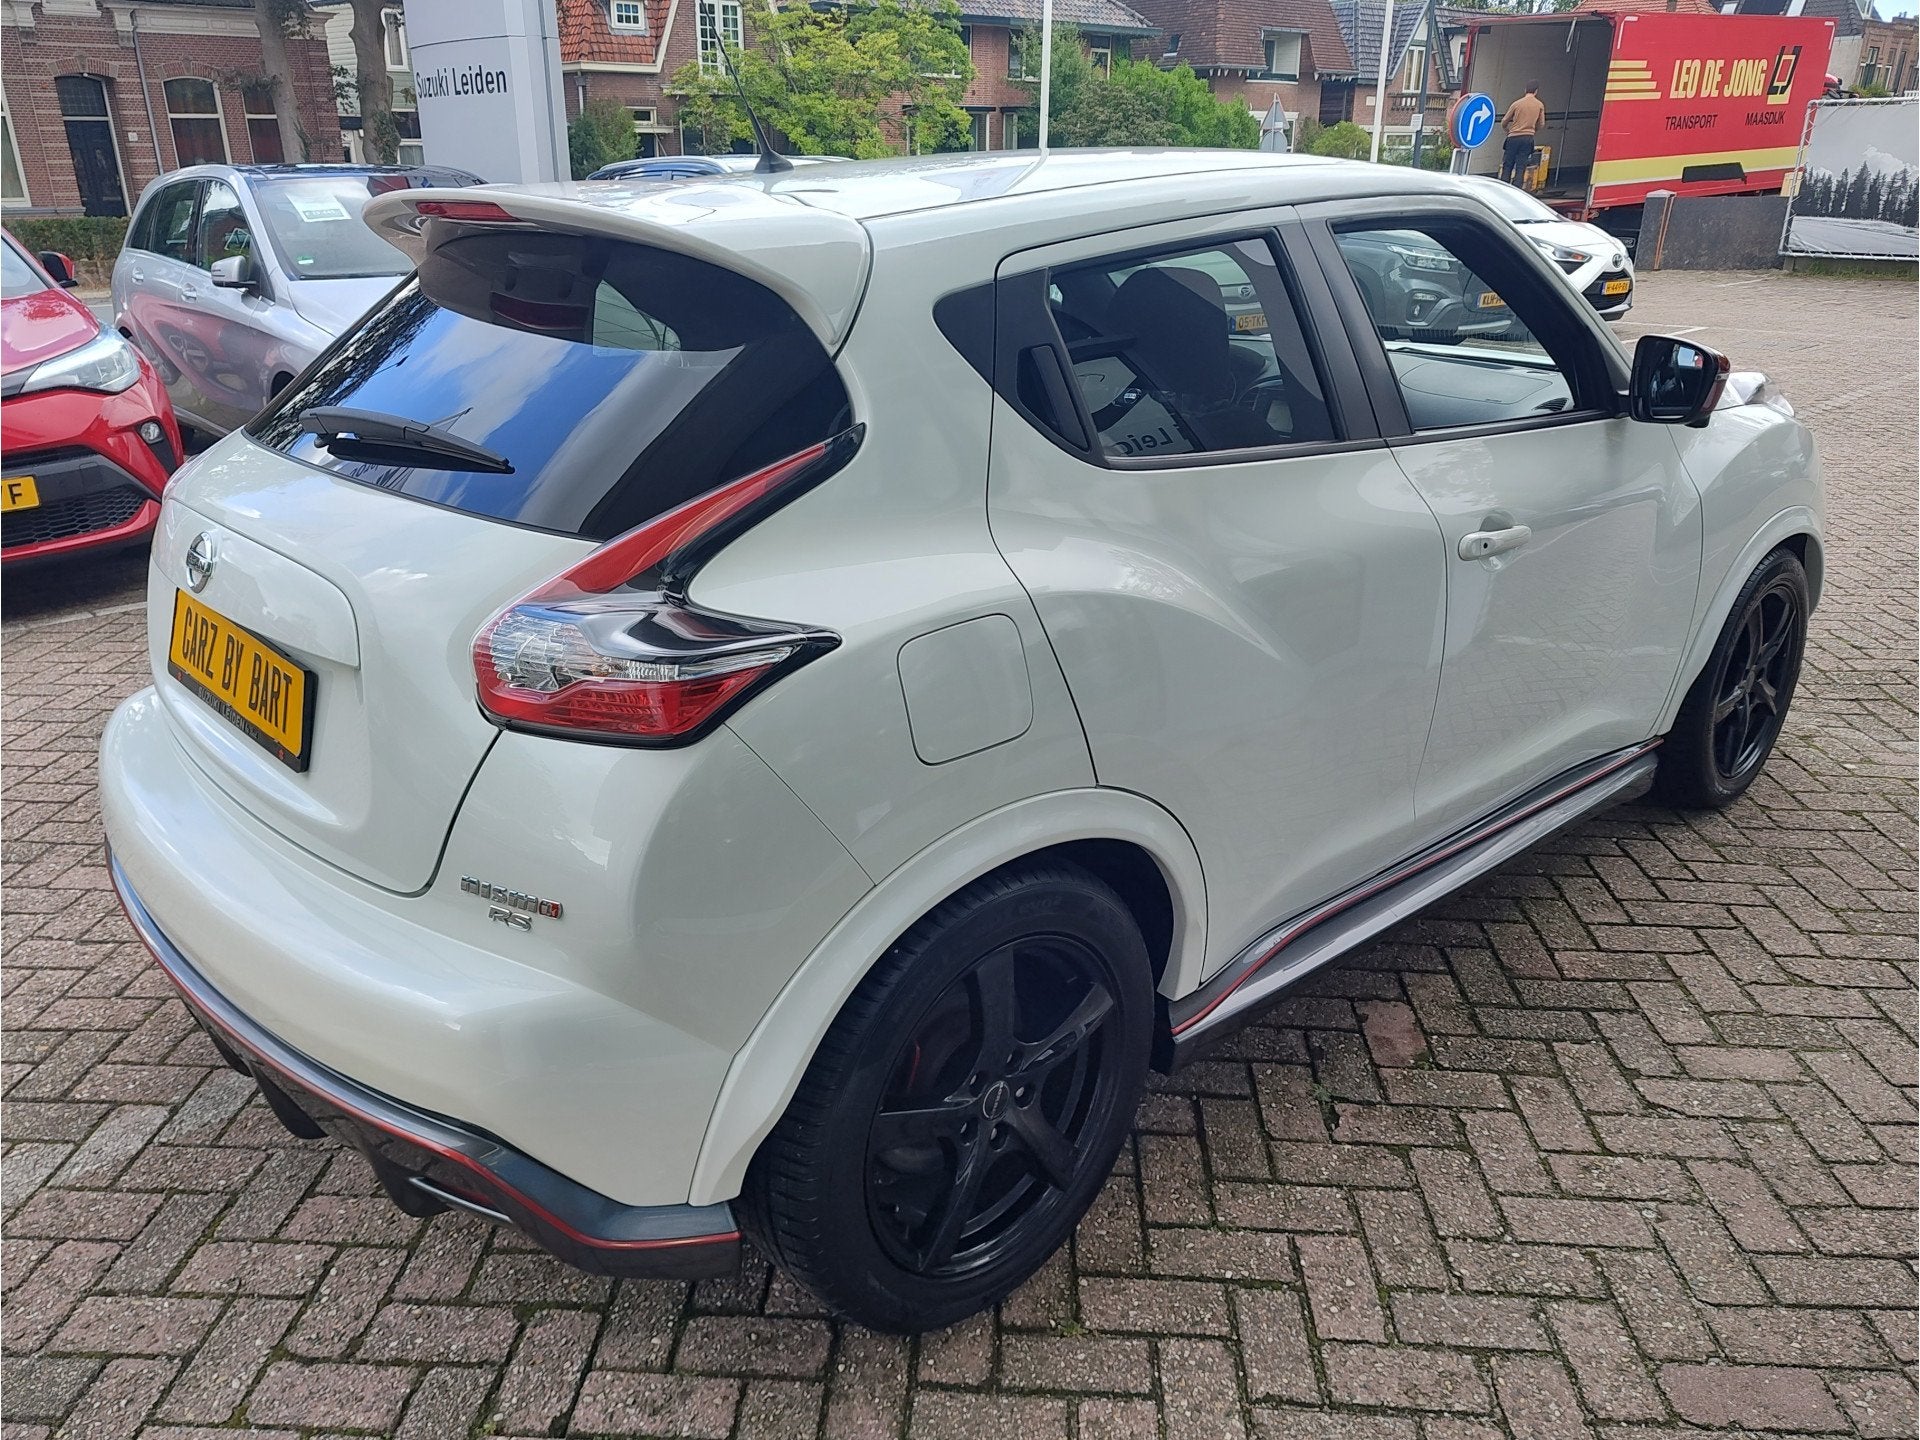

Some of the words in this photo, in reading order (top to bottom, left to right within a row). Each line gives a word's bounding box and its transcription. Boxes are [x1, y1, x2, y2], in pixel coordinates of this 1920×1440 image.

[415, 68, 450, 99] Suzuki
[452, 65, 507, 96] Leiden
[1669, 59, 1701, 99] LEO
[1700, 59, 1724, 98] DE
[1723, 58, 1768, 97] JONG
[1665, 114, 1718, 131] TRANSPORT
[1745, 111, 1786, 126] MAASDIJK
[182, 606, 218, 680] CARZ
[222, 633, 245, 698] BY
[248, 651, 292, 734] BART
[488, 904, 532, 932] RS
